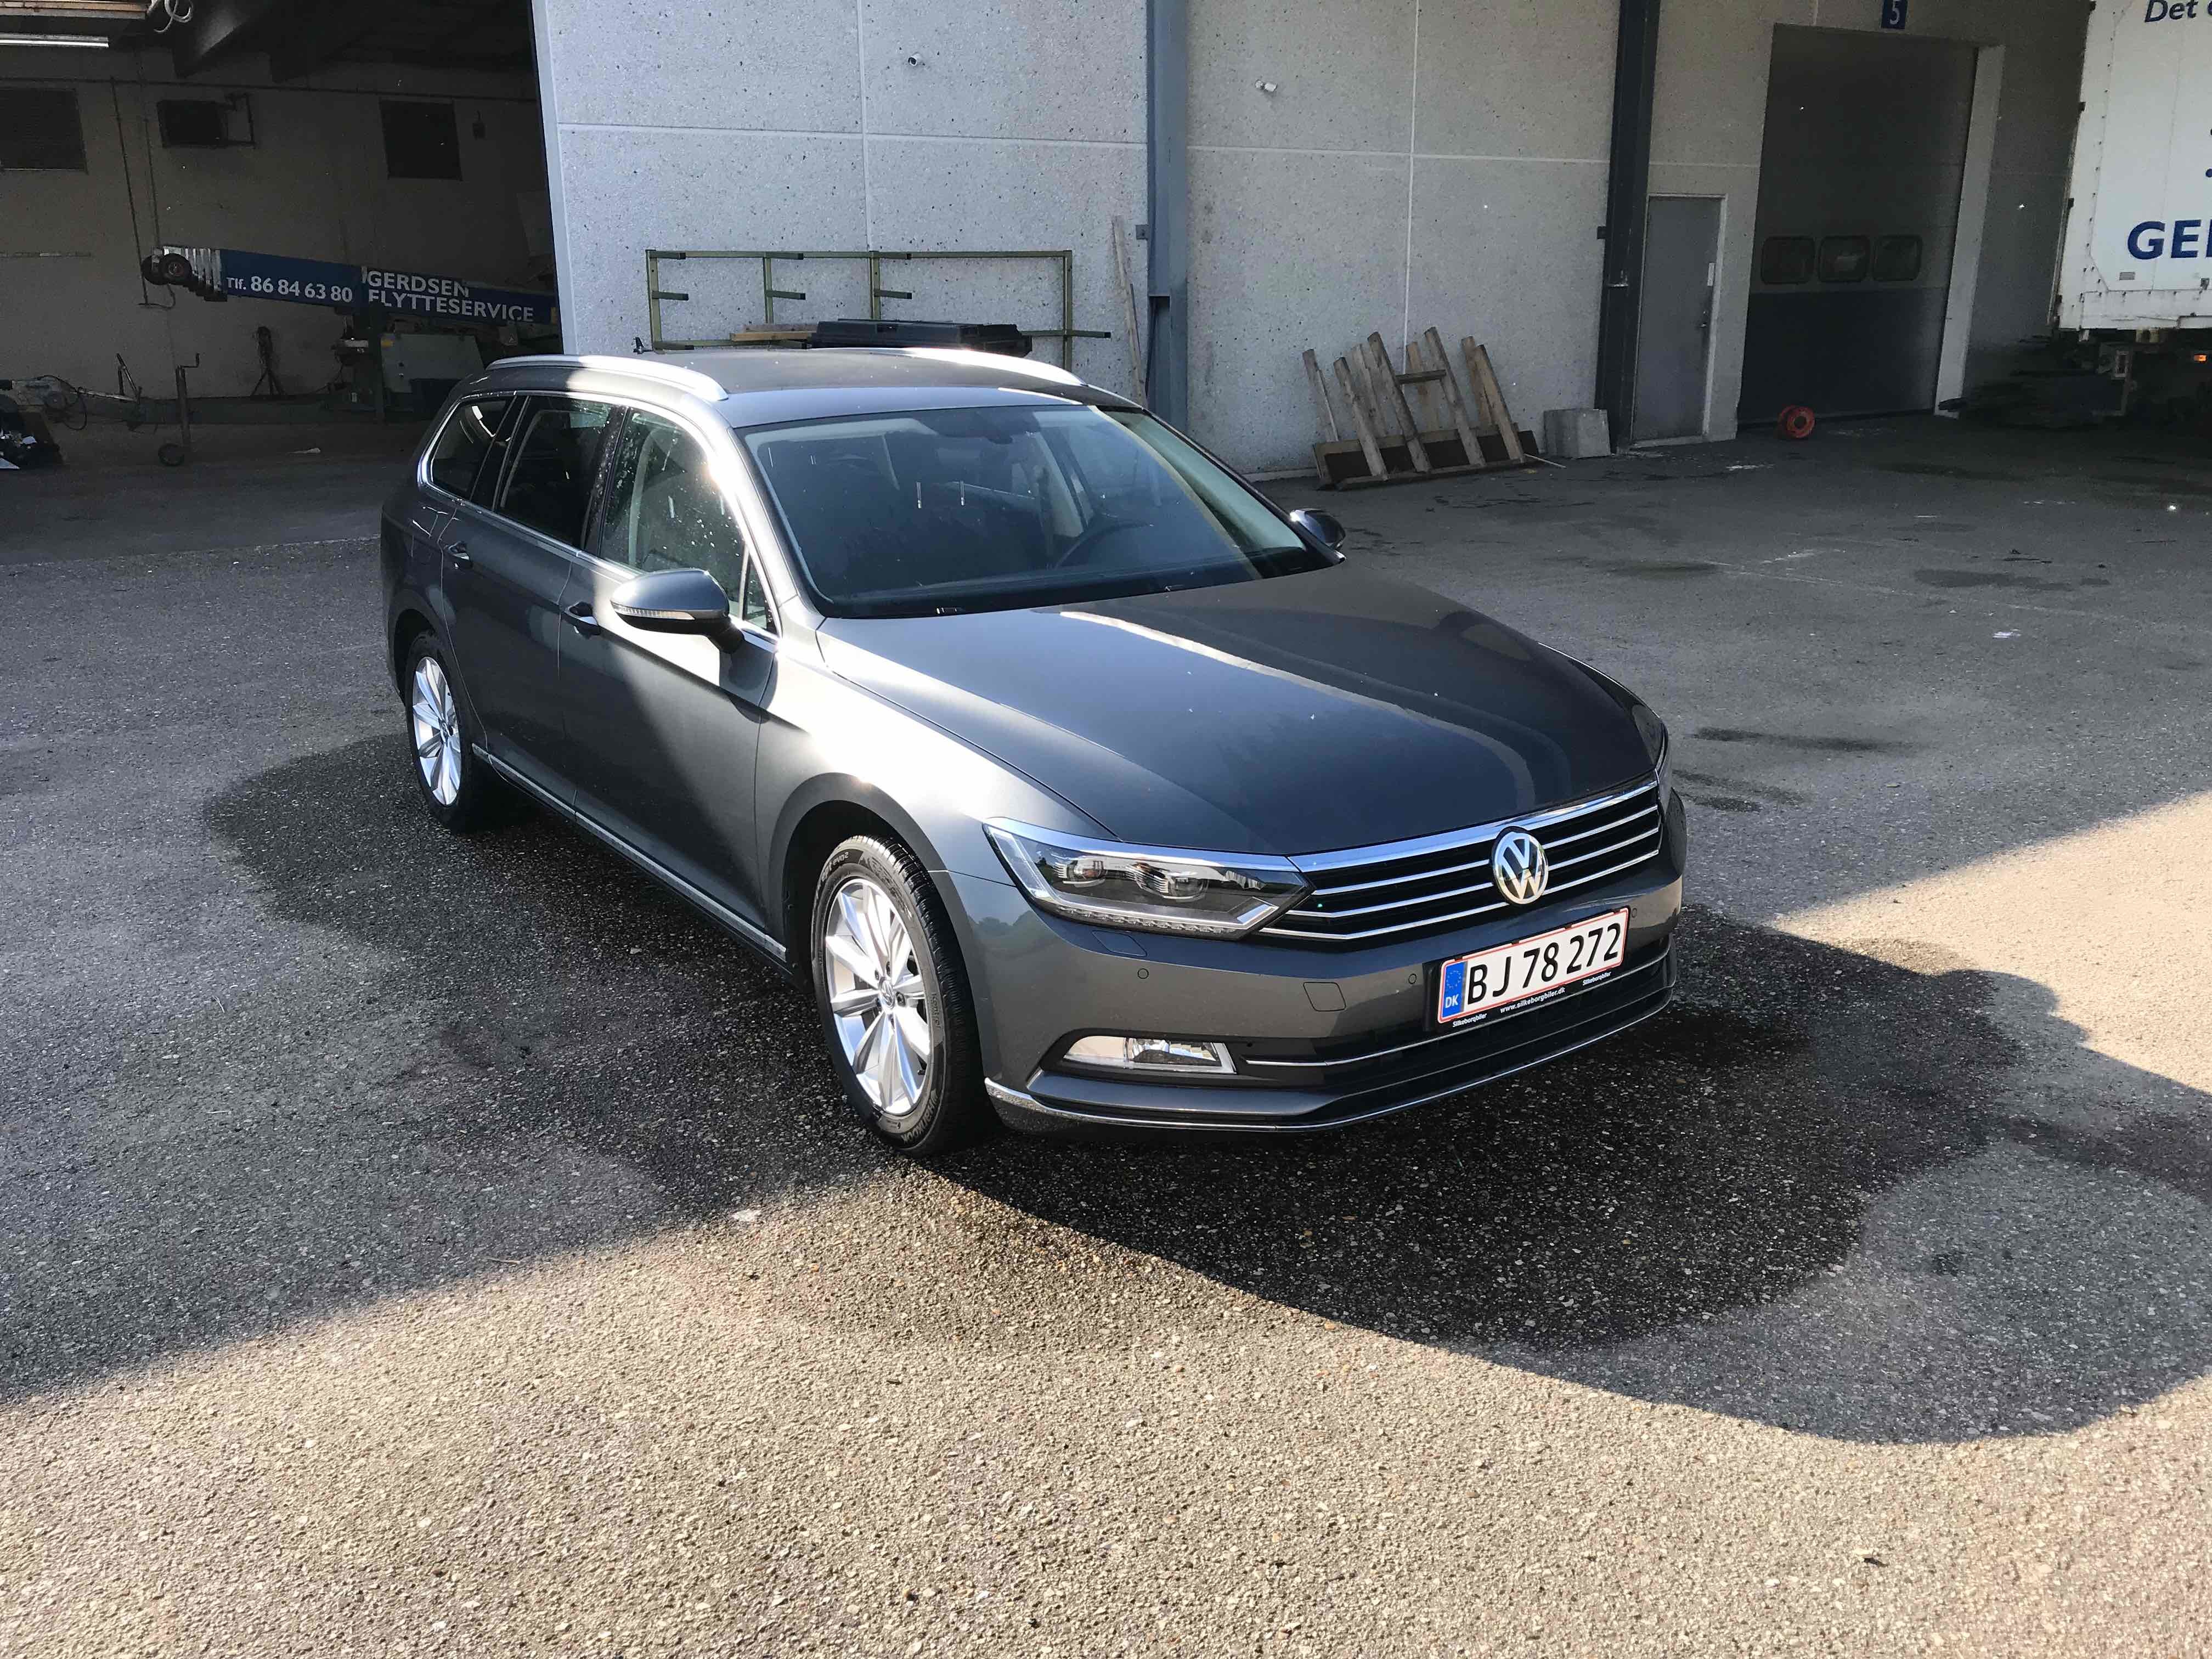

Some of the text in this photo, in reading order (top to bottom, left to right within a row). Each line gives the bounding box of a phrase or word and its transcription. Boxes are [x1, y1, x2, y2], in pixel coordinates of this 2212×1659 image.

[1889, 0, 1900, 25] 5
[2144, 0, 2198, 22] Det
[2127, 219, 2212, 260] GE
[226, 275, 353, 303] Tlf. 86 84 63 80
[367, 270, 470, 297] GERDSEN
[368, 289, 534, 323] FLYTTESERVICE
[1467, 923, 1621, 1005] BJ 78 272
[1445, 994, 1459, 1009] DK
[1452, 1012, 1487, 1028] Silkeborgbiler
[1499, 987, 1565, 1014] www.silkeborgbiler.dk
